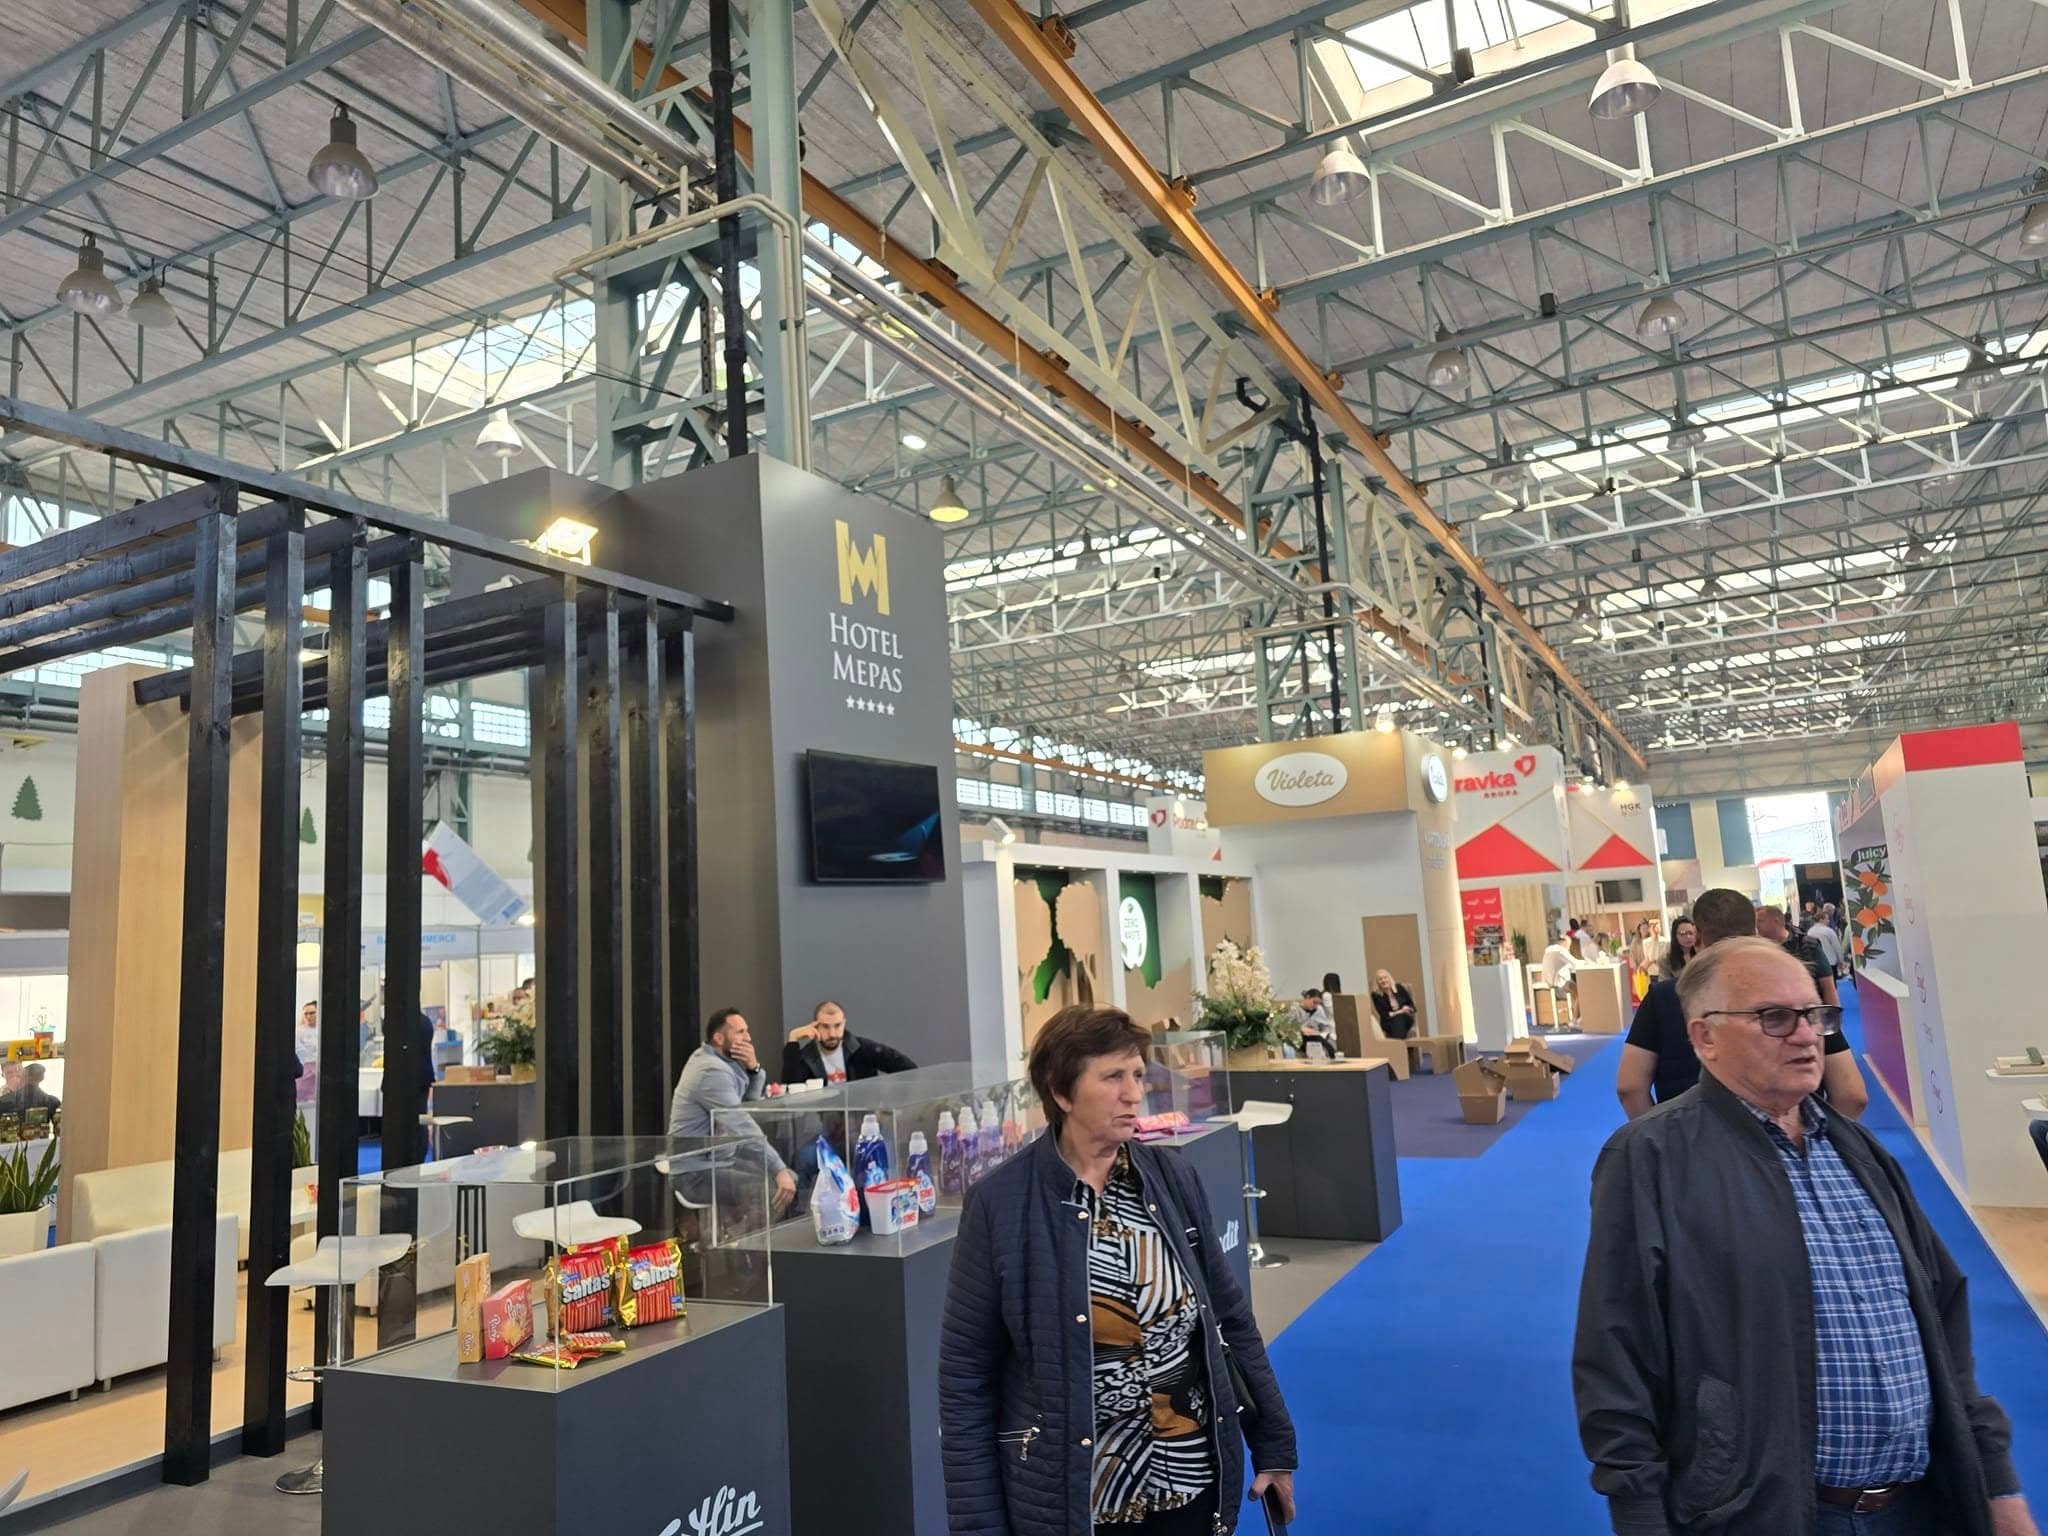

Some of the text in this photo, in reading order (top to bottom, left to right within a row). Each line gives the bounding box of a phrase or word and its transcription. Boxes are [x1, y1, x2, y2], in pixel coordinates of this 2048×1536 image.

[830, 612, 904, 659] HOTEL
[833, 651, 903, 693] MEPAS
[1266, 768, 1335, 791] Violeta
[1454, 771, 1517, 793] ravka
